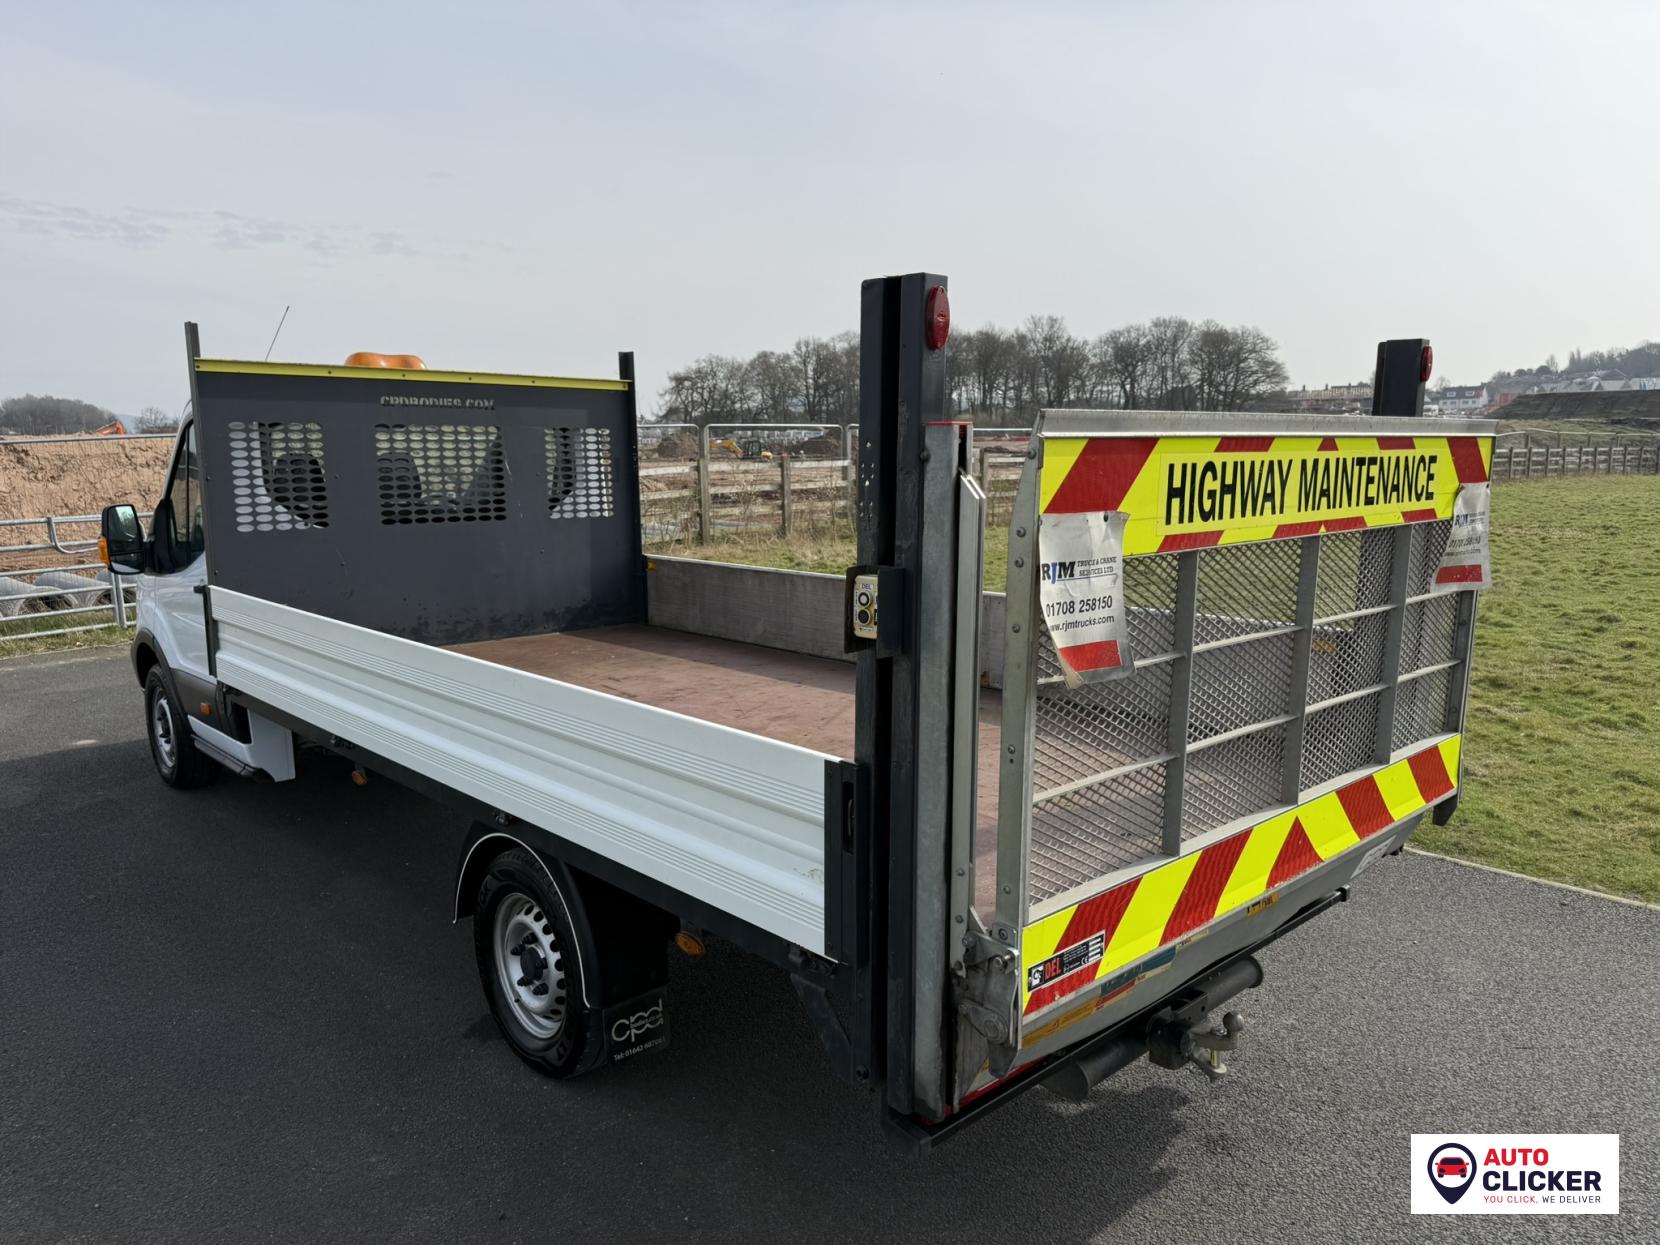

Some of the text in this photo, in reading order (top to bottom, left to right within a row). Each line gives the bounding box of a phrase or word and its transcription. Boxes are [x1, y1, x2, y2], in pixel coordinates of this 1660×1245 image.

[1165, 454, 1437, 526] HIGHWAY MAINTENANCE
[1041, 561, 1075, 584] RJM
[1077, 559, 1095, 568] TRUCK
[1046, 595, 1113, 617] 01708 258150
[1045, 957, 1062, 980] DEL
[612, 998, 663, 1041] cpd
